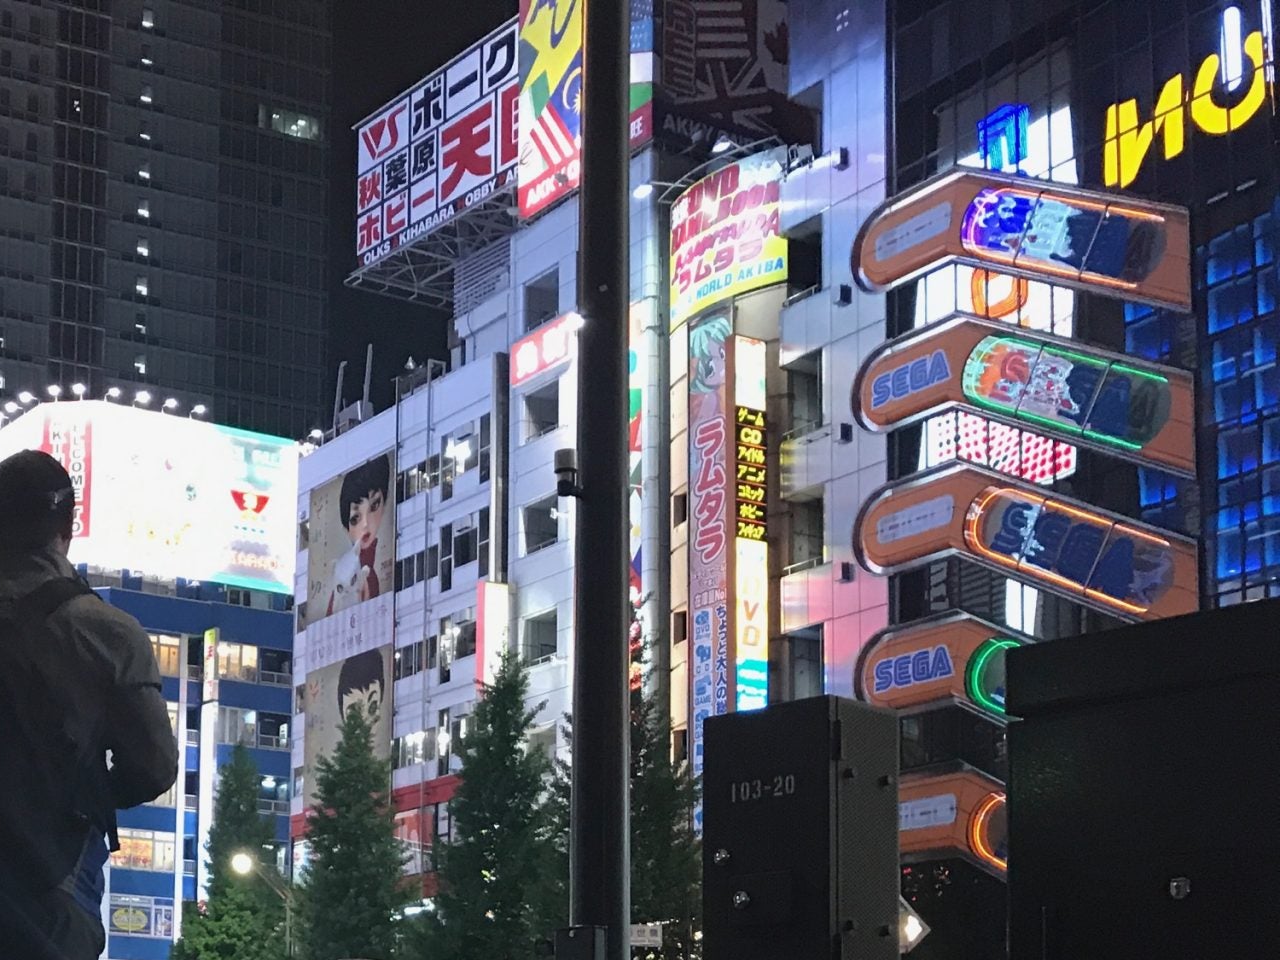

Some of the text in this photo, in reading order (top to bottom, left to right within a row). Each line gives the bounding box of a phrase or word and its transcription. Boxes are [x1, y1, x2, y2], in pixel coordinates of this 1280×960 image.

[440, 84, 519, 202] 天
[359, 138, 436, 209] 秋葉原
[359, 188, 436, 250] ホビー
[696, 257, 784, 299] WORLD AKIBA
[872, 350, 951, 408] SEGA
[740, 427, 762, 444] CD
[694, 418, 725, 565] ラムタラ
[737, 465, 766, 482] アニメ
[875, 645, 954, 692] SEGA
[731, 775, 795, 803] 103-20
